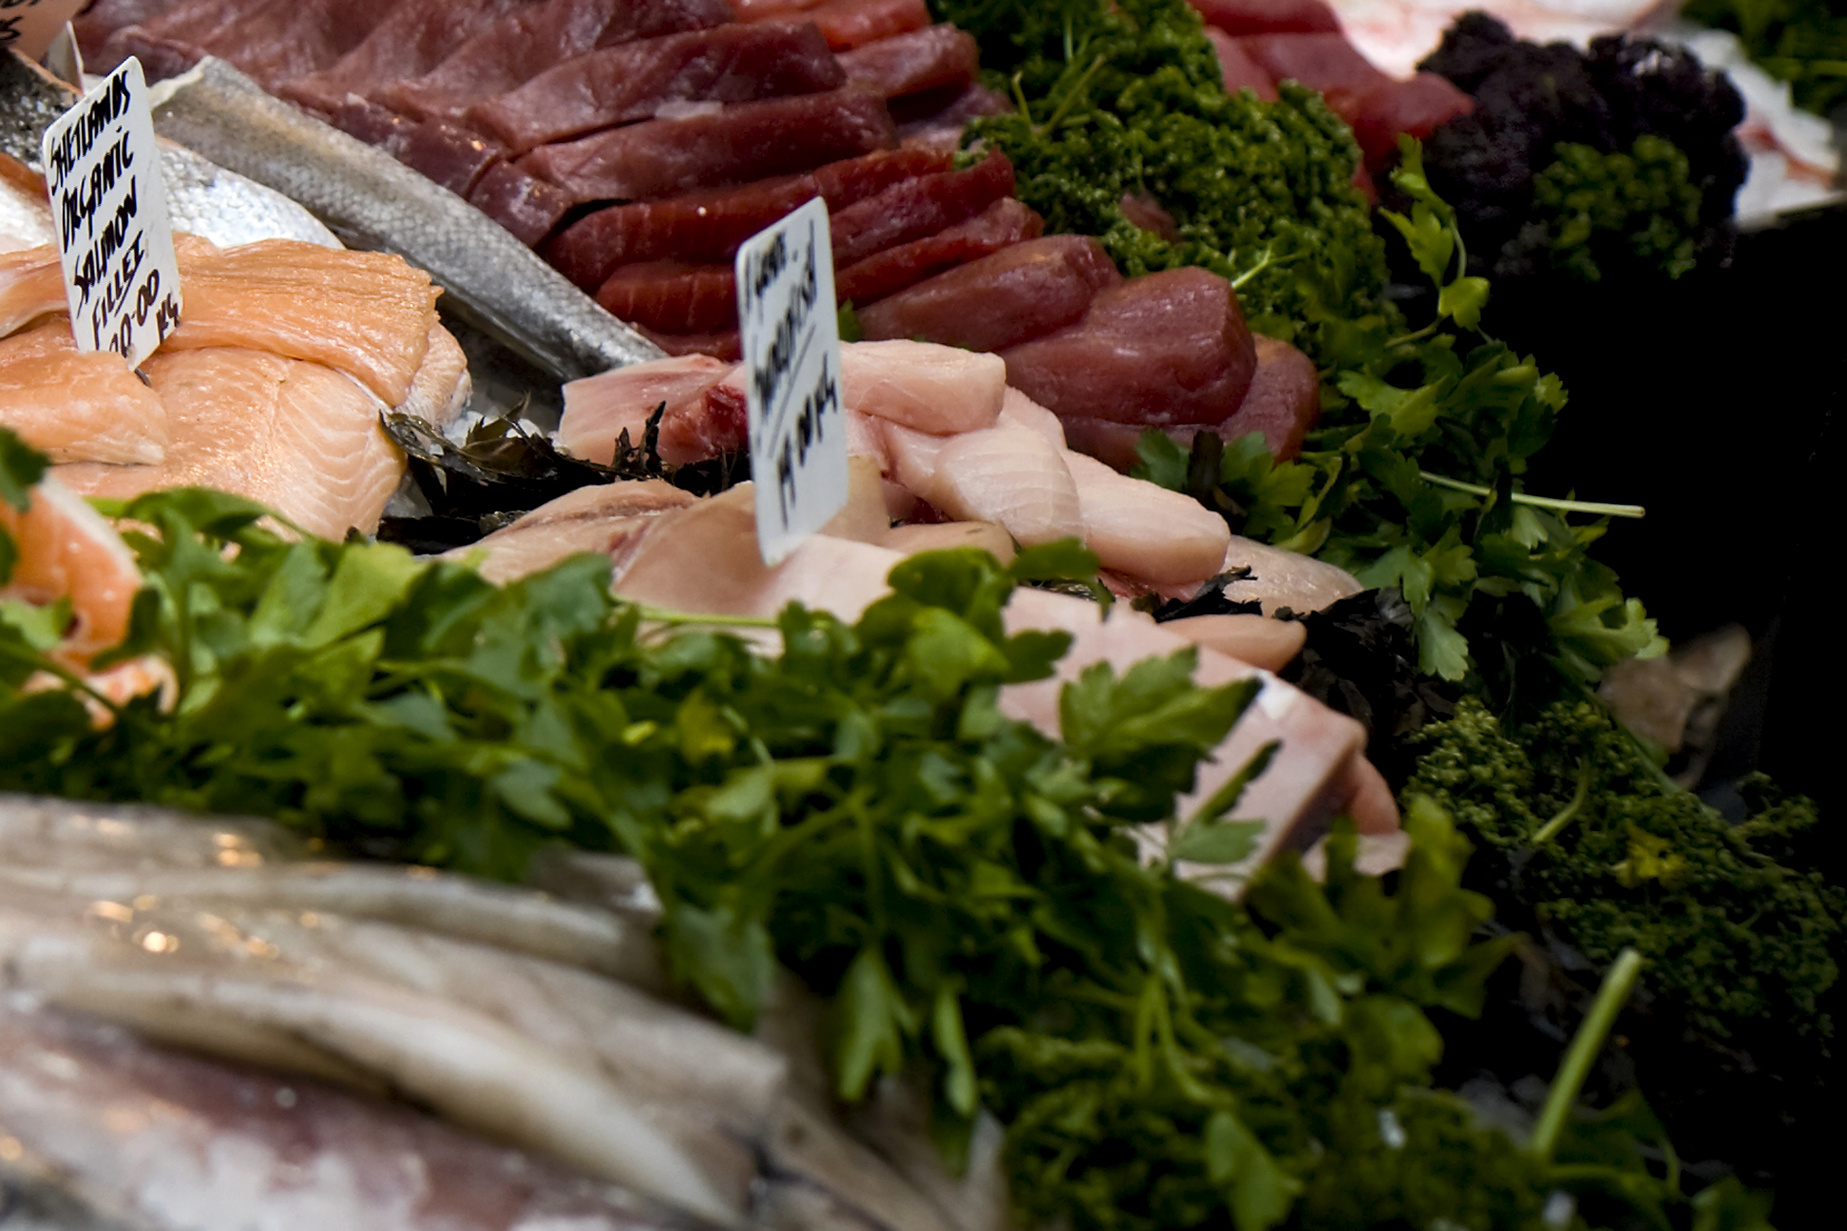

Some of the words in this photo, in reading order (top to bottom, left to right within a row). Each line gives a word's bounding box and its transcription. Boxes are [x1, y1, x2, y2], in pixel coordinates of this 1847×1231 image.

[62, 124, 134, 254] ORGANIC
[73, 174, 139, 319] SALMON
[91, 230, 145, 351] FILLET
